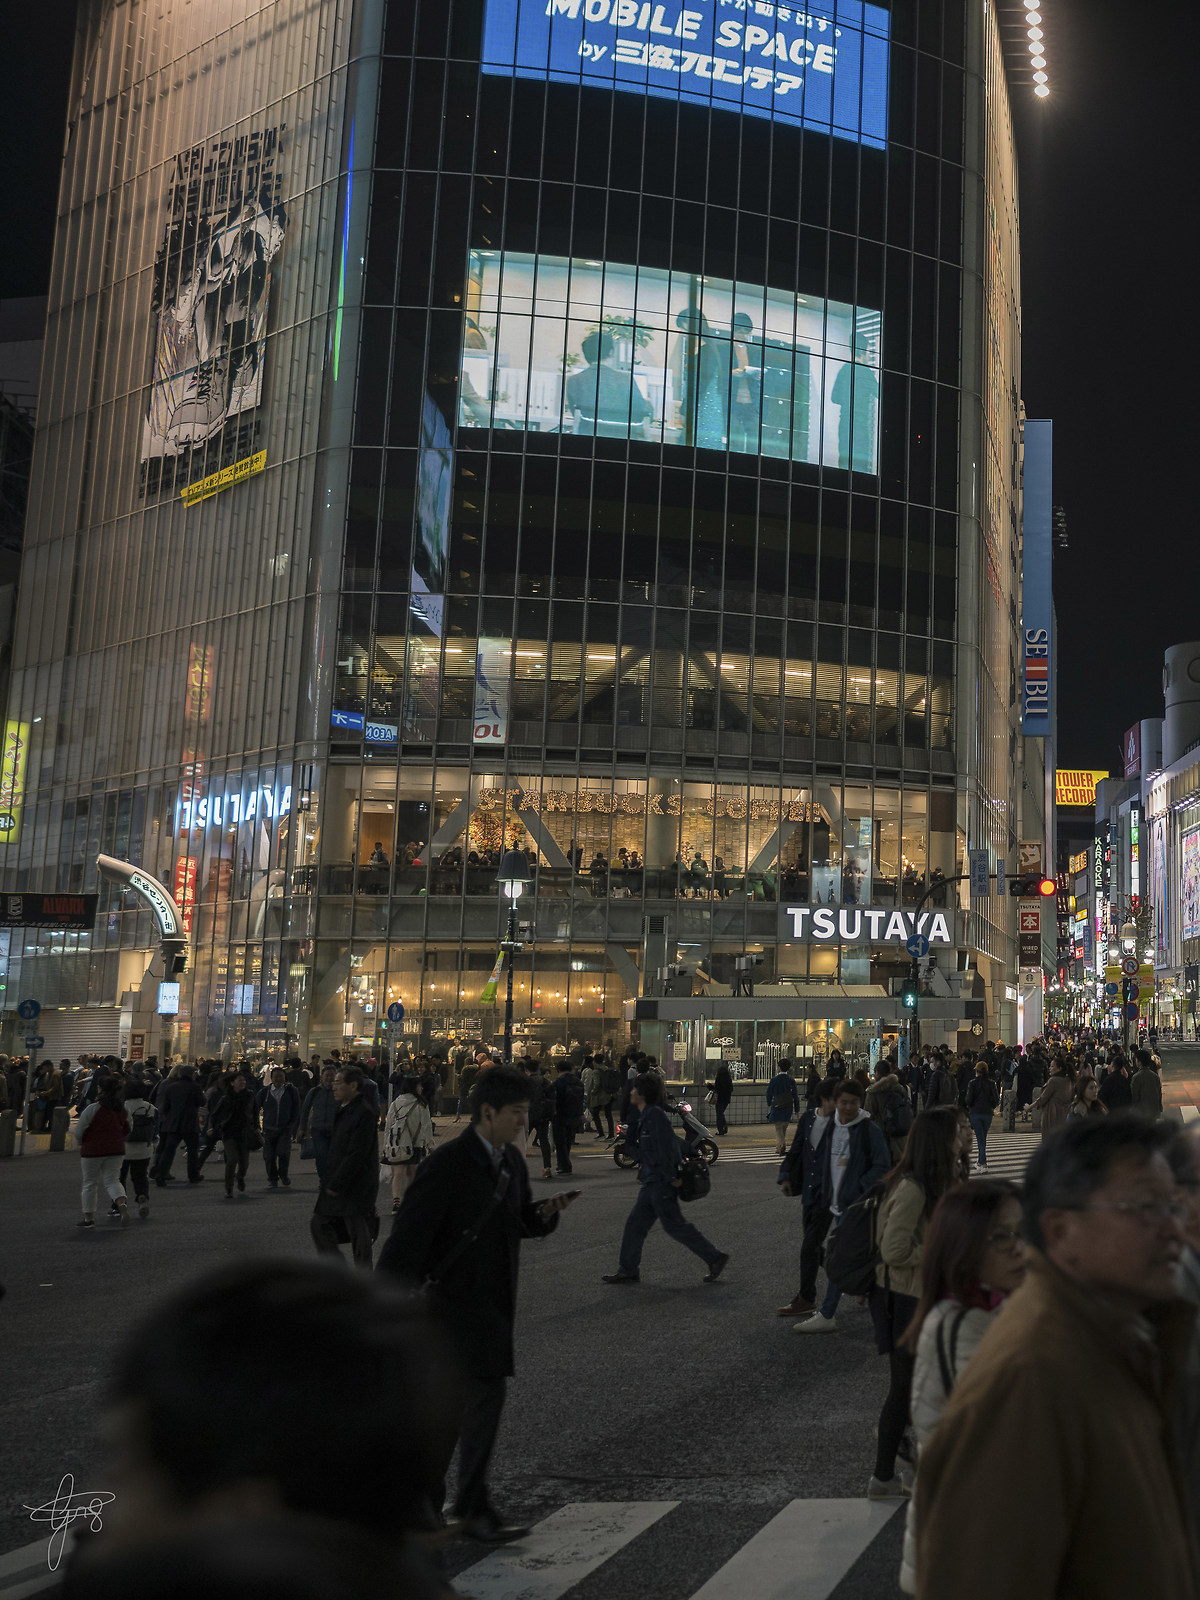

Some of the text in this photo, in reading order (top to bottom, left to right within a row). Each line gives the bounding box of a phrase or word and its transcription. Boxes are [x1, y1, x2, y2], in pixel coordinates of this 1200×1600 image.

[545, 0, 838, 74] MOBILE SPACE
[578, 39, 803, 96] by 三協フロンテア
[1025, 628, 1048, 714] SEIBU
[1056, 771, 1094, 788] TOWER
[181, 785, 292, 830] TSUTAYA
[477, 787, 822, 823] STARBUCKS COFFEE
[977, 853, 987, 893] 渋谷駅前
[1094, 837, 1103, 888] KARAOKE
[133, 875, 174, 932] 渋谷センター街
[786, 907, 951, 942] TSUTAYA
[1023, 914, 1038, 929] 本
[404, 1008, 501, 1018] ARBUCKS COFFEE
